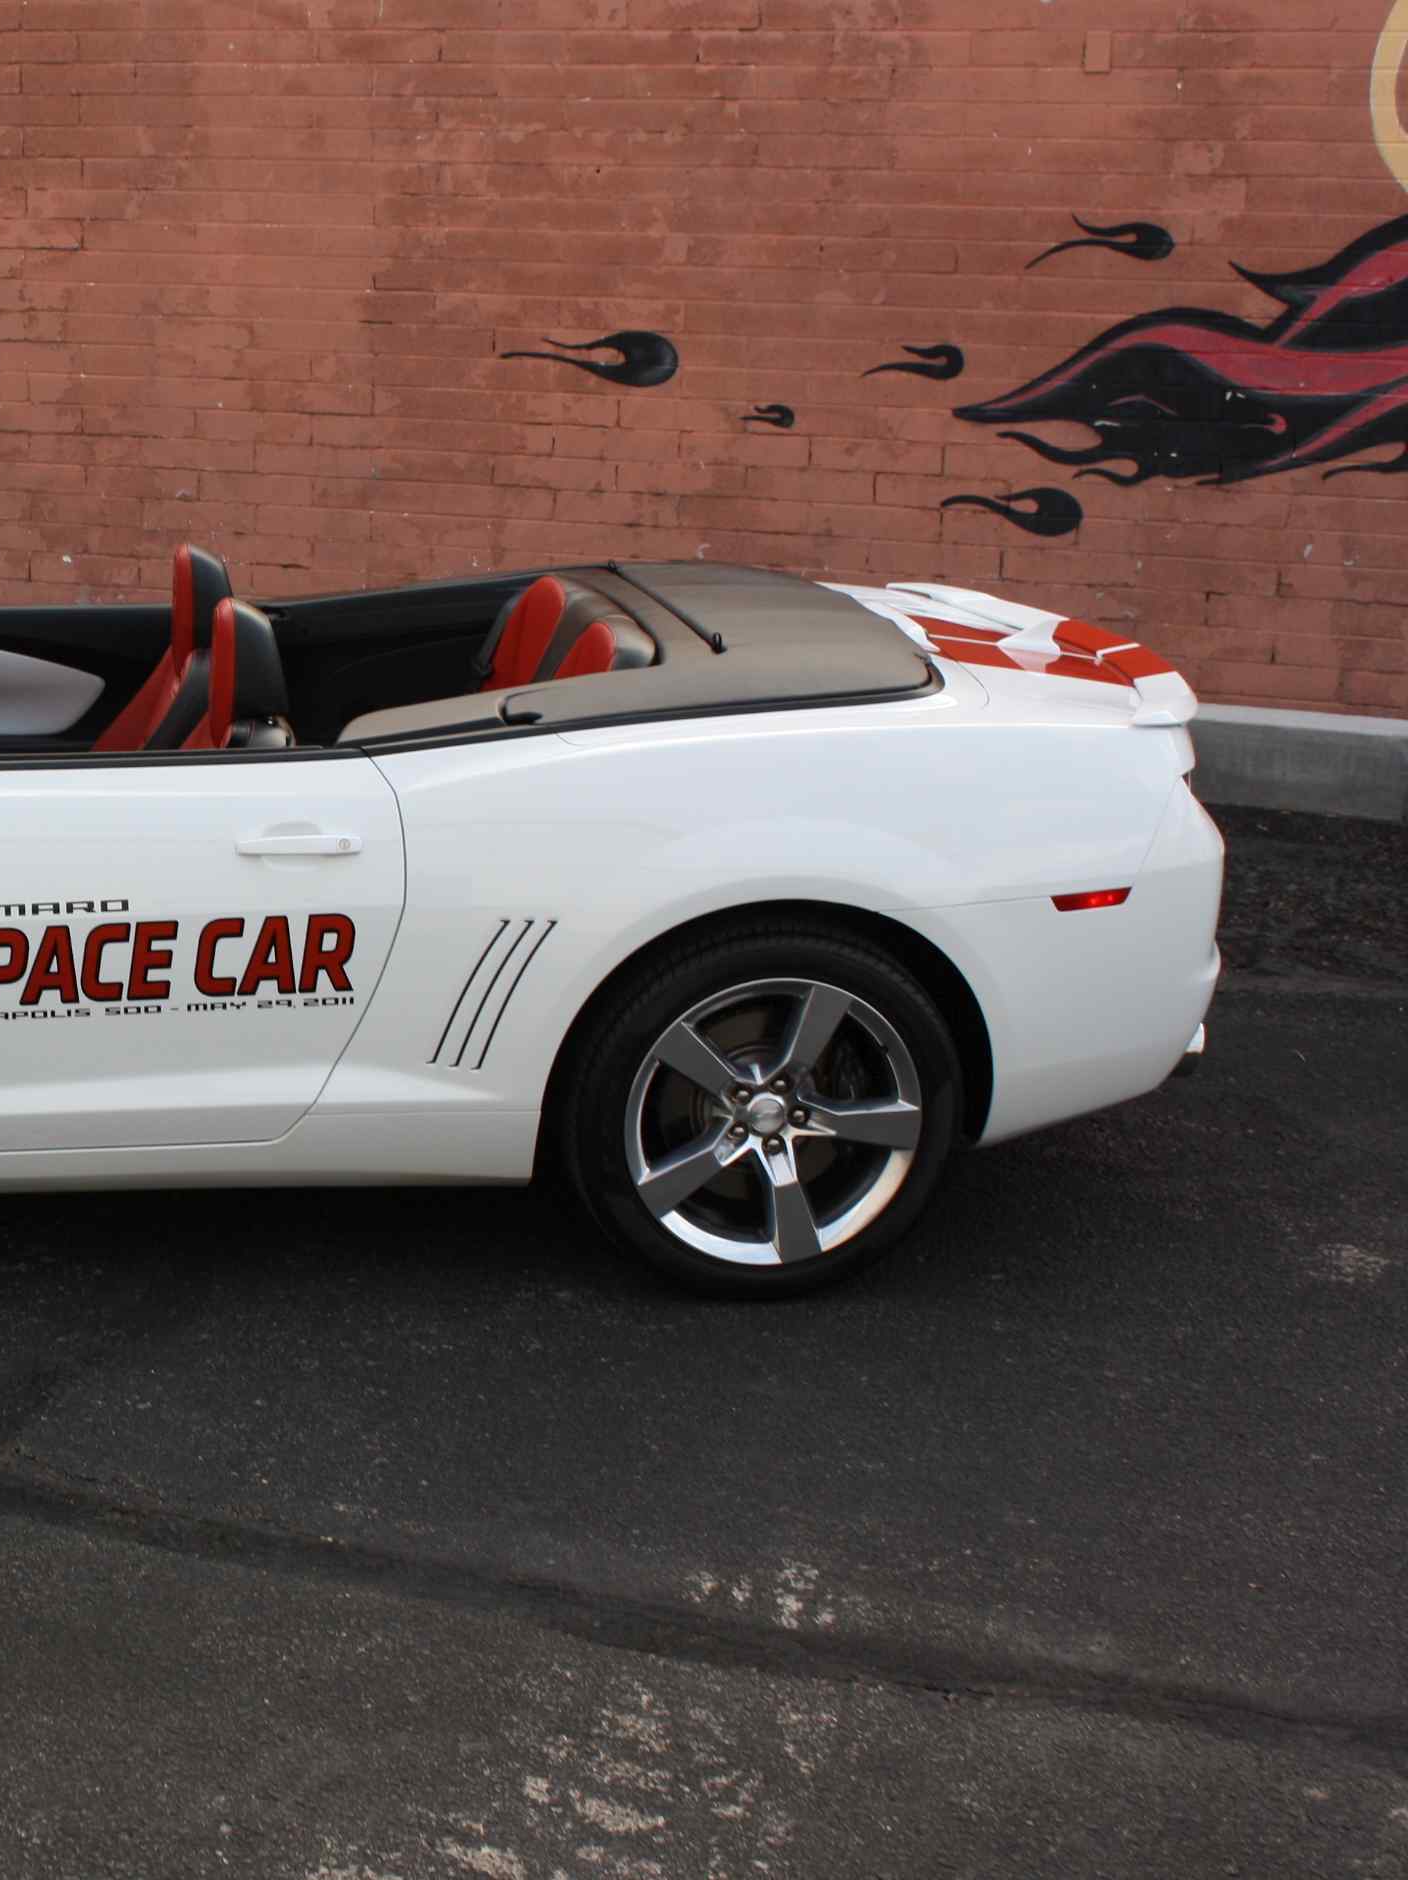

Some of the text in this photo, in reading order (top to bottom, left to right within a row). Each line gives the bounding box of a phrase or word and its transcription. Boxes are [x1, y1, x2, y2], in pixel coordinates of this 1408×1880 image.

[193, 912, 356, 998] CAR
[105, 1004, 162, 1016] 500
[186, 1001, 247, 1013] MAY
[303, 996, 355, 1007] 2011
